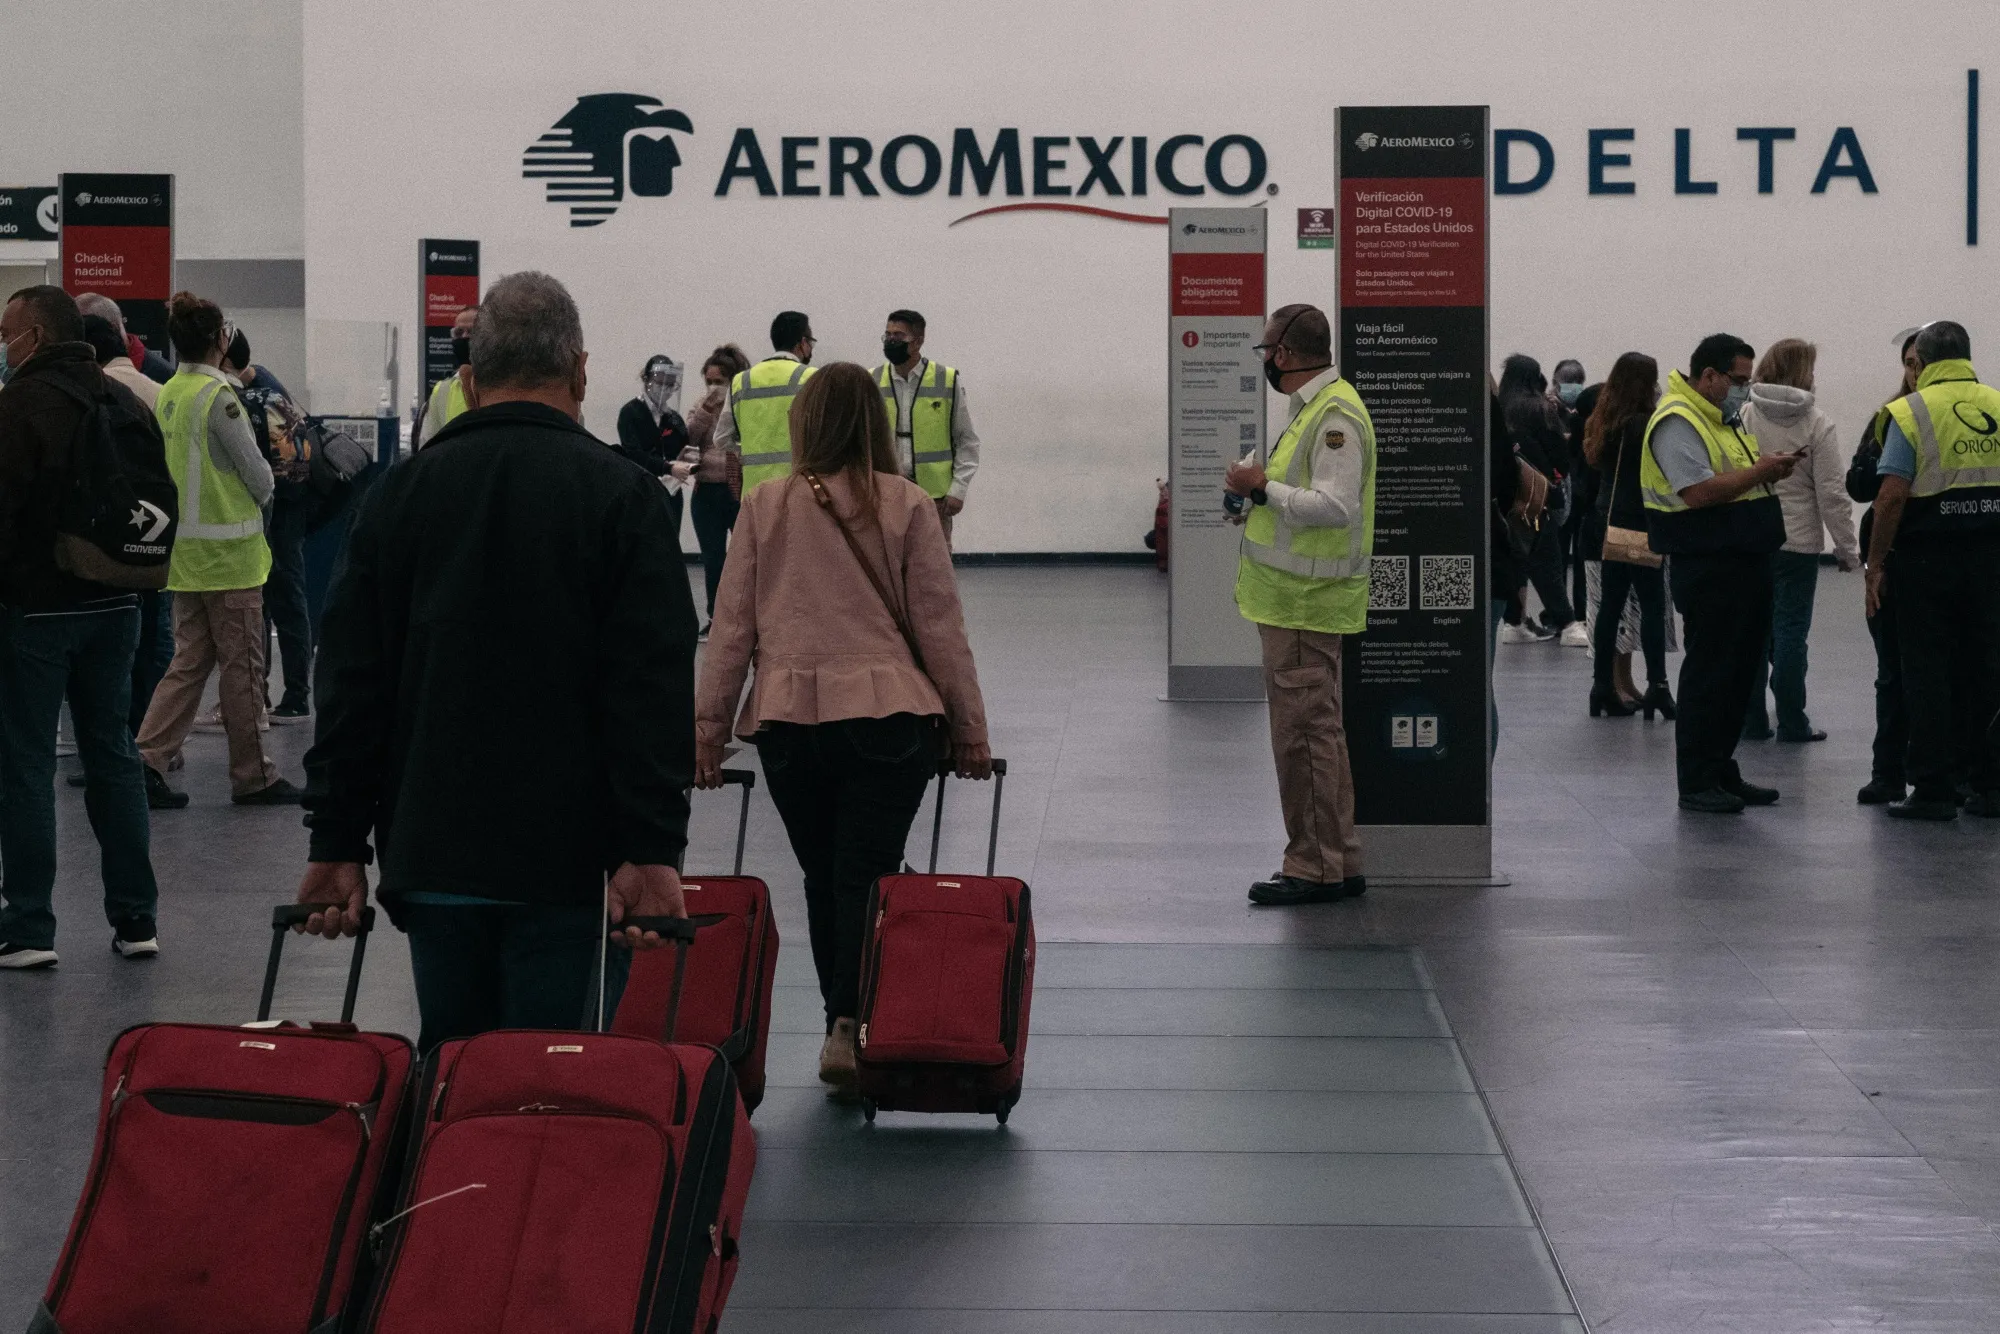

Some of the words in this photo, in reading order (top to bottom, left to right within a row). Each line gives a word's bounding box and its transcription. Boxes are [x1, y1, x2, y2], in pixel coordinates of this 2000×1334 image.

[1380, 136, 1455, 148] AEROMEXICO
[714, 127, 1268, 197] AEROMEXICO
[1493, 126, 1879, 196] DELTA
[93, 196, 148, 205] AEROMEXICO
[1356, 191, 1423, 202] Verificación
[1356, 207, 1392, 219] Digital
[1395, 207, 1453, 218] COVID-19
[1198, 226, 1245, 234] AEROMEXICO
[1356, 225, 1381, 235] para
[1384, 223, 1430, 234] Estados
[1433, 222, 1474, 233] Unidos
[1355, 241, 1379, 249] Digital
[75, 253, 124, 263] Check-in
[75, 266, 122, 276] nacional
[1373, 270, 1409, 279] pasajeros
[1410, 271, 1425, 279] que
[1426, 270, 1448, 279] viajan
[1181, 277, 1244, 286] Documentos
[1181, 288, 1238, 298] obligatorios
[1356, 323, 1380, 334] Viaja
[1382, 323, 1404, 333] fácil
[1203, 331, 1250, 341] Importante
[1356, 337, 1375, 345] con
[1377, 336, 1438, 345] Aeroméxico
[1356, 371, 1375, 379] Solo
[1376, 371, 1418, 380] pasajeros
[1420, 372, 1437, 380] que
[1438, 371, 1463, 380] viajan
[1356, 382, 1391, 390] Estados
[1392, 382, 1425, 390] Unidos:
[1390, 398, 1421, 406] proceso
[1422, 397, 1431, 405] de
[1400, 426, 1410, 434] de
[1940, 500, 1978, 515] SERVICIO
[123, 543, 167, 554] CONVERSE
[1368, 617, 1398, 625] Español
[1433, 617, 1460, 625] English
